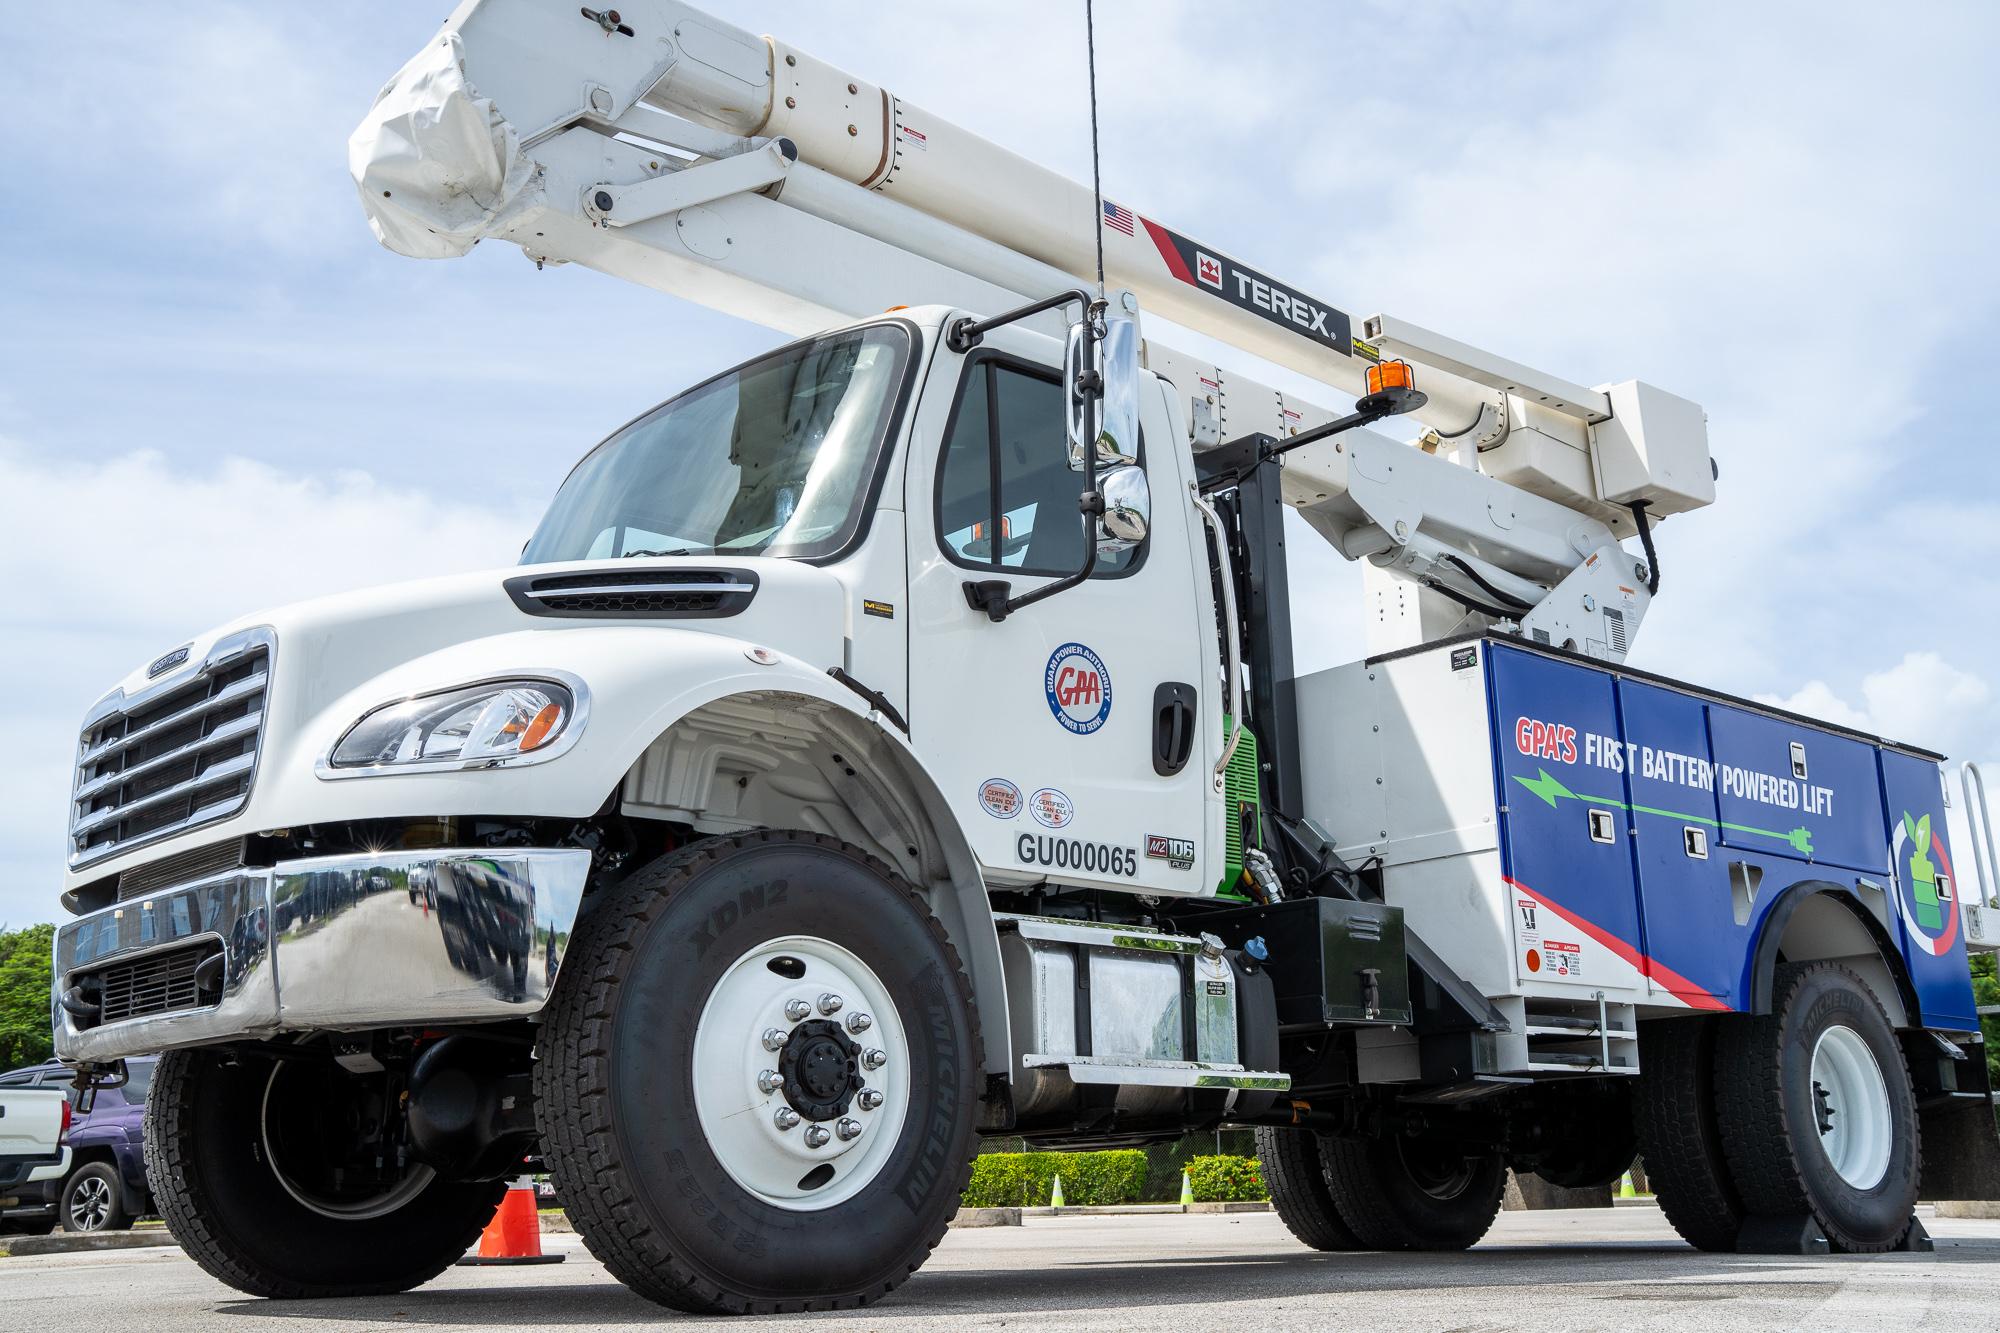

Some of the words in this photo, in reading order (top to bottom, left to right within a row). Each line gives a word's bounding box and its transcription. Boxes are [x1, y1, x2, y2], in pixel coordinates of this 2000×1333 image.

[1232, 269, 1330, 338] TEREX
[1047, 659, 1058, 693] GUAM
[1055, 645, 1083, 662] POWER
[1083, 650, 1111, 702] AUTHORITY
[1057, 710, 1078, 732] POWER
[1078, 723, 1088, 733] TO
[1087, 715, 1103, 732] SERVE
[1516, 717, 1577, 765] GPA'S
[1585, 733, 1637, 775] FIRST
[1642, 746, 1719, 793] BATTERY
[1722, 764, 1799, 809] POWERED
[1802, 783, 1834, 817] LIFT
[985, 795, 1003, 804] CLEAN
[987, 789, 1015, 800] CERTIFIED
[1039, 799, 1065, 809] CERTIFIED
[1036, 805, 1054, 813] CLEAN
[1017, 833, 1137, 877] GU000065
[1149, 839, 1166, 854] M2
[1169, 840, 1194, 858] 106
[906, 1006, 957, 1201] MICHELIN
